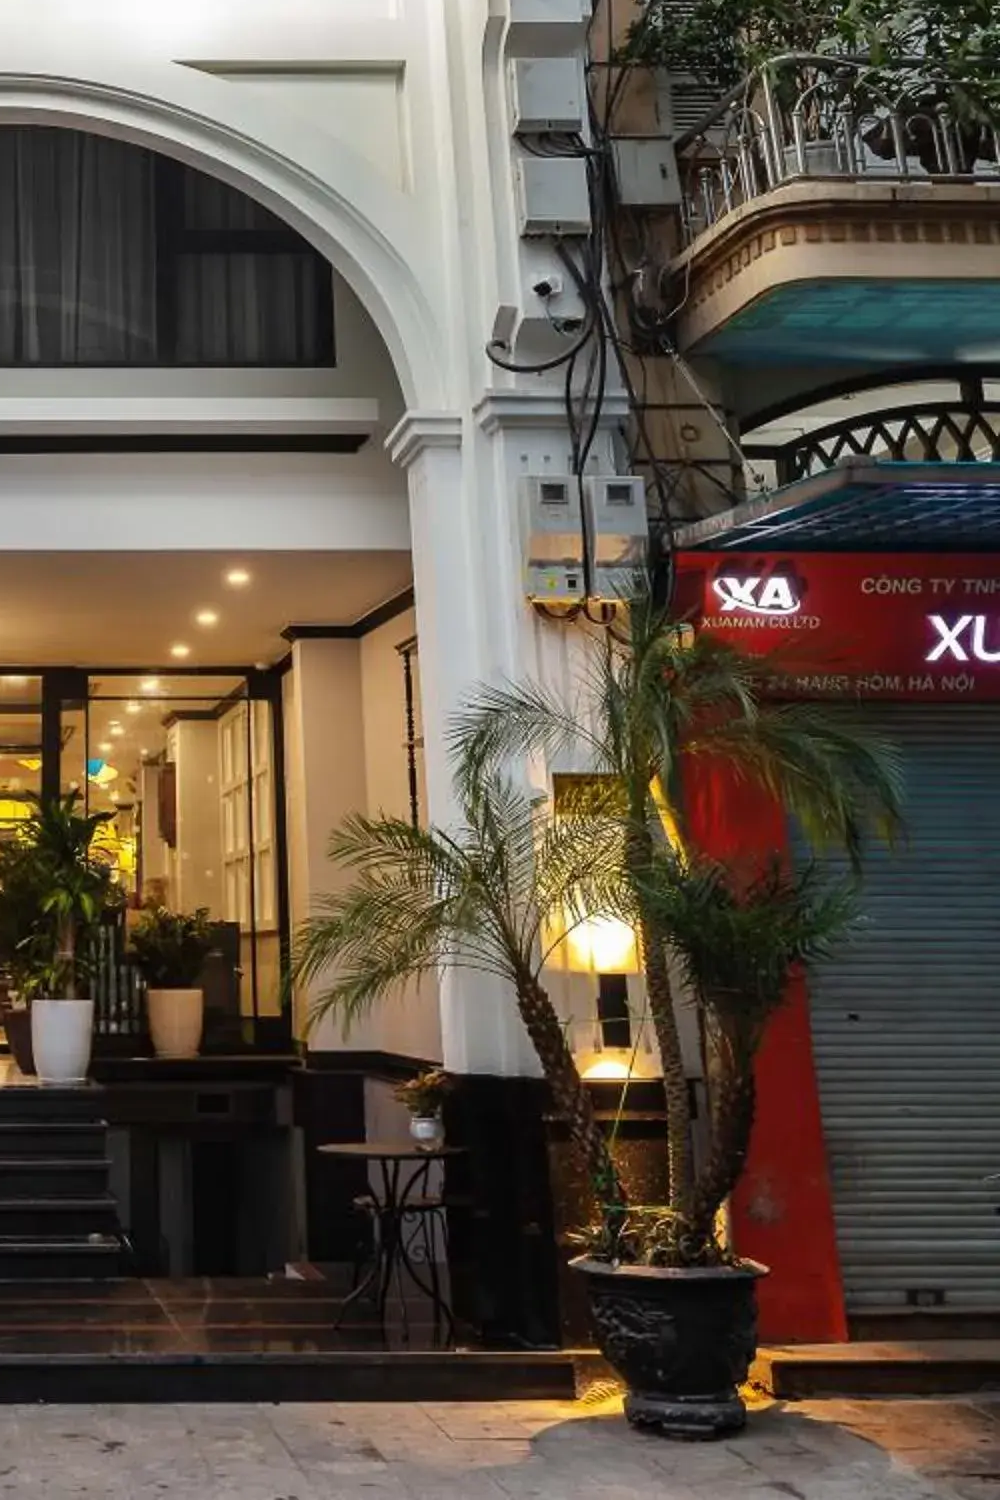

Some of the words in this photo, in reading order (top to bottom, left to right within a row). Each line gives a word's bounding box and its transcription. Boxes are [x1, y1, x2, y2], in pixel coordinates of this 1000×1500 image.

[861, 573, 922, 594] CÔNG
[930, 579, 955, 594] TY
[925, 615, 1000, 662] XU
